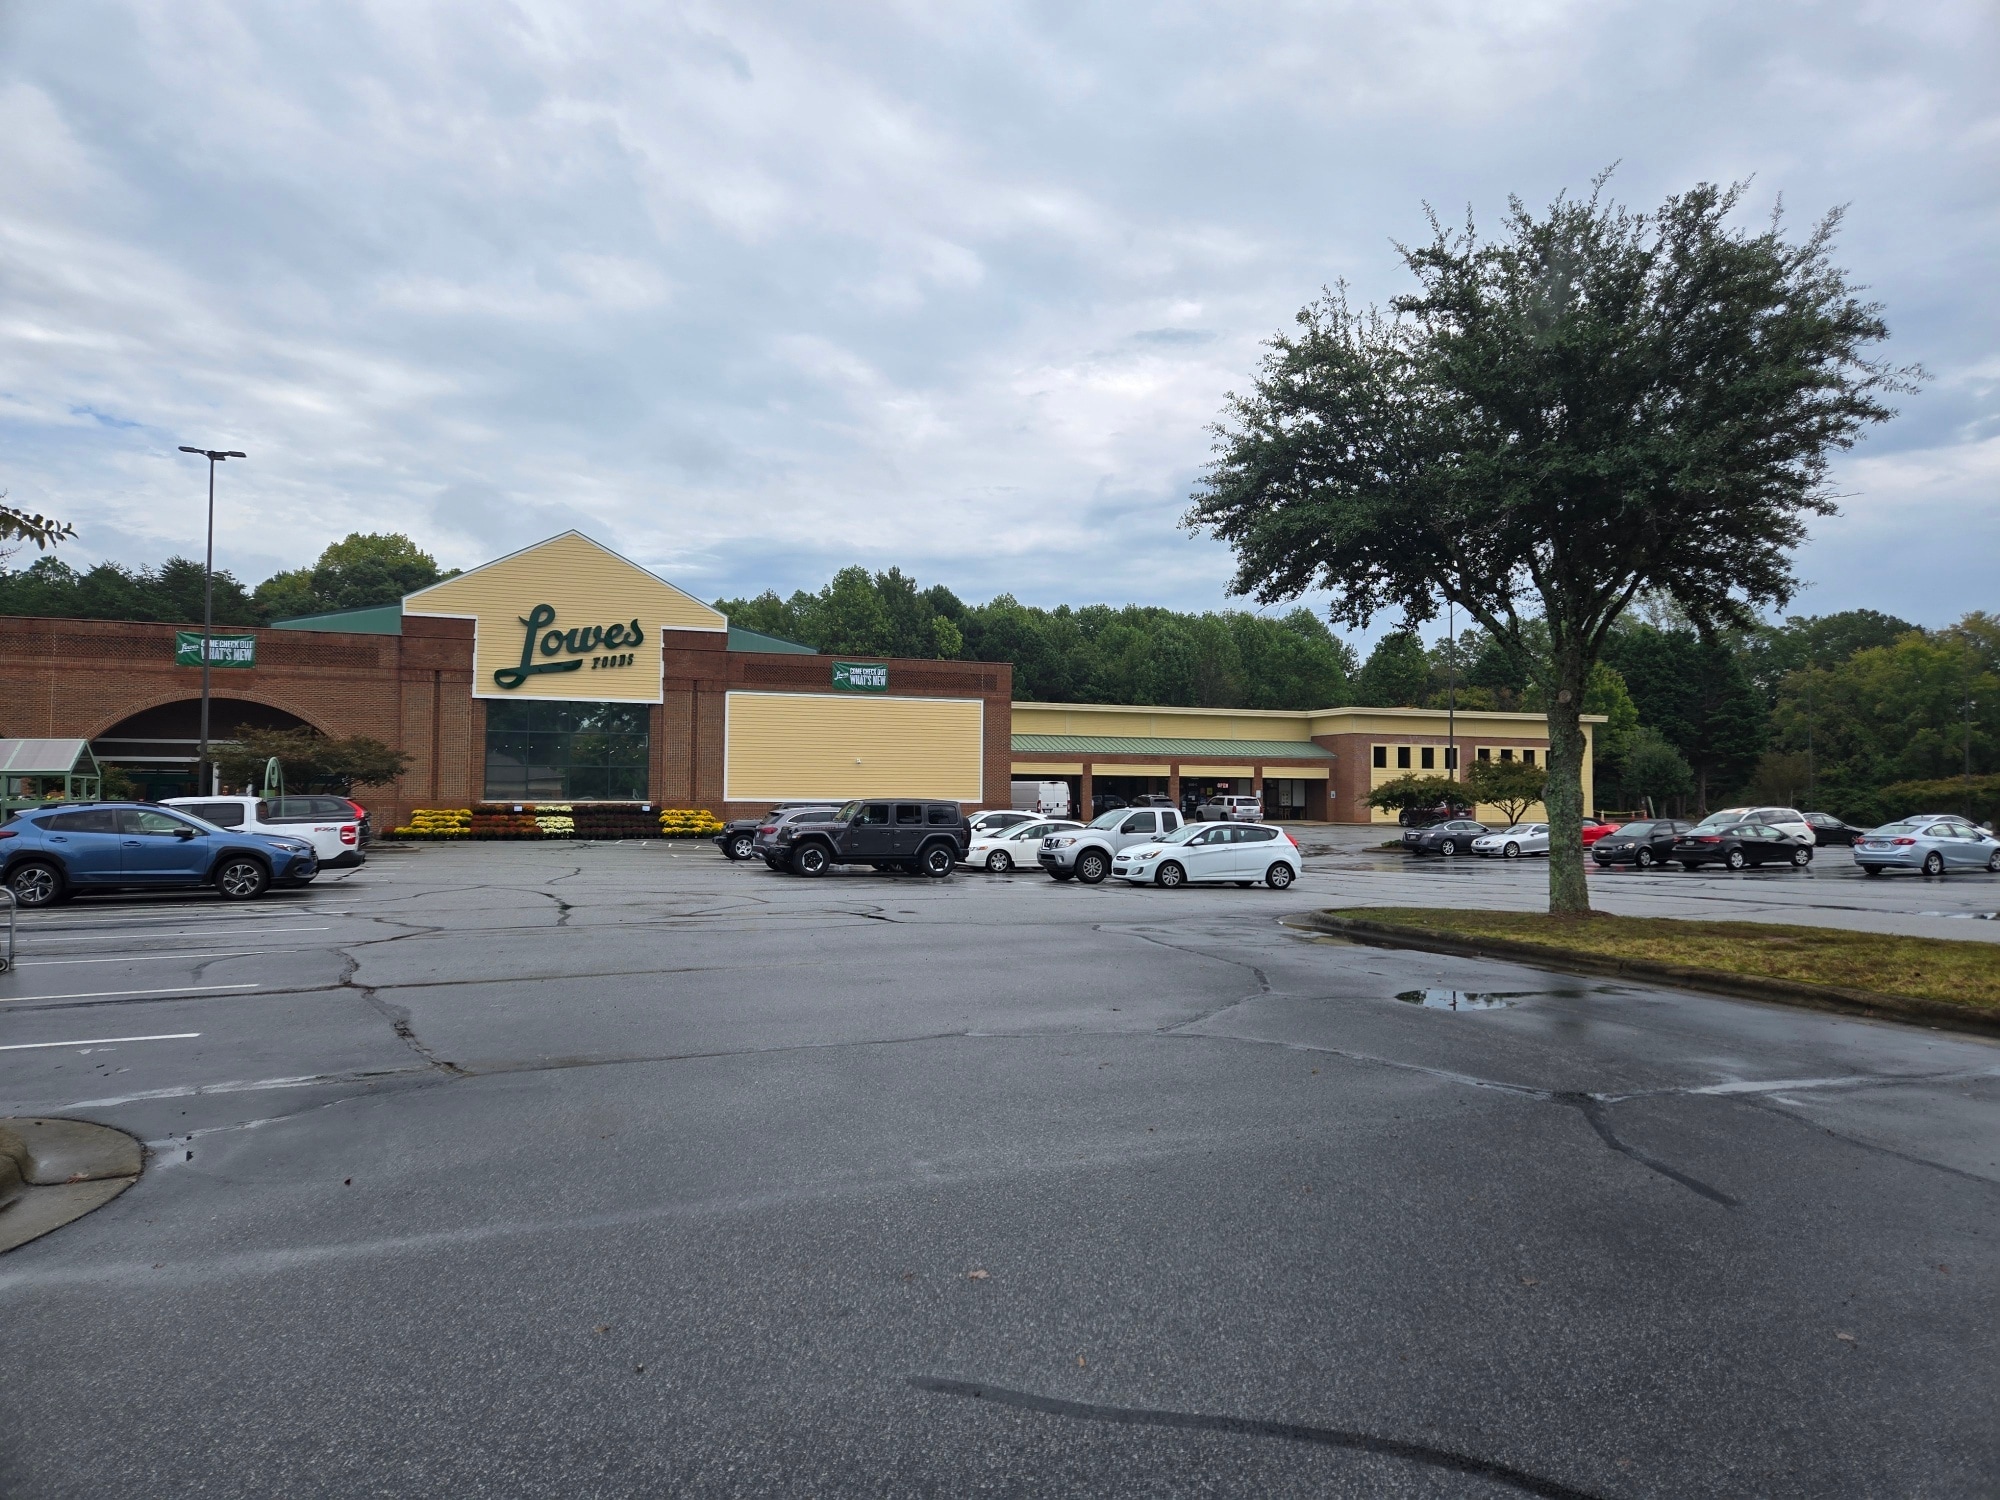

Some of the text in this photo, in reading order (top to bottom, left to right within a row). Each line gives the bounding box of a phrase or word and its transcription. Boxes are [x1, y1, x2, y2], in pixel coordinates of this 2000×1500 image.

[201, 639, 254, 649] CME CHECK OUT
[494, 604, 644, 689] Lowes
[234, 648, 253, 661] NEW
[592, 653, 634, 670] FOODS
[850, 667, 862, 675] COME
[863, 668, 876, 676] CHECK
[850, 674, 886, 686] WHAT'S NEW
